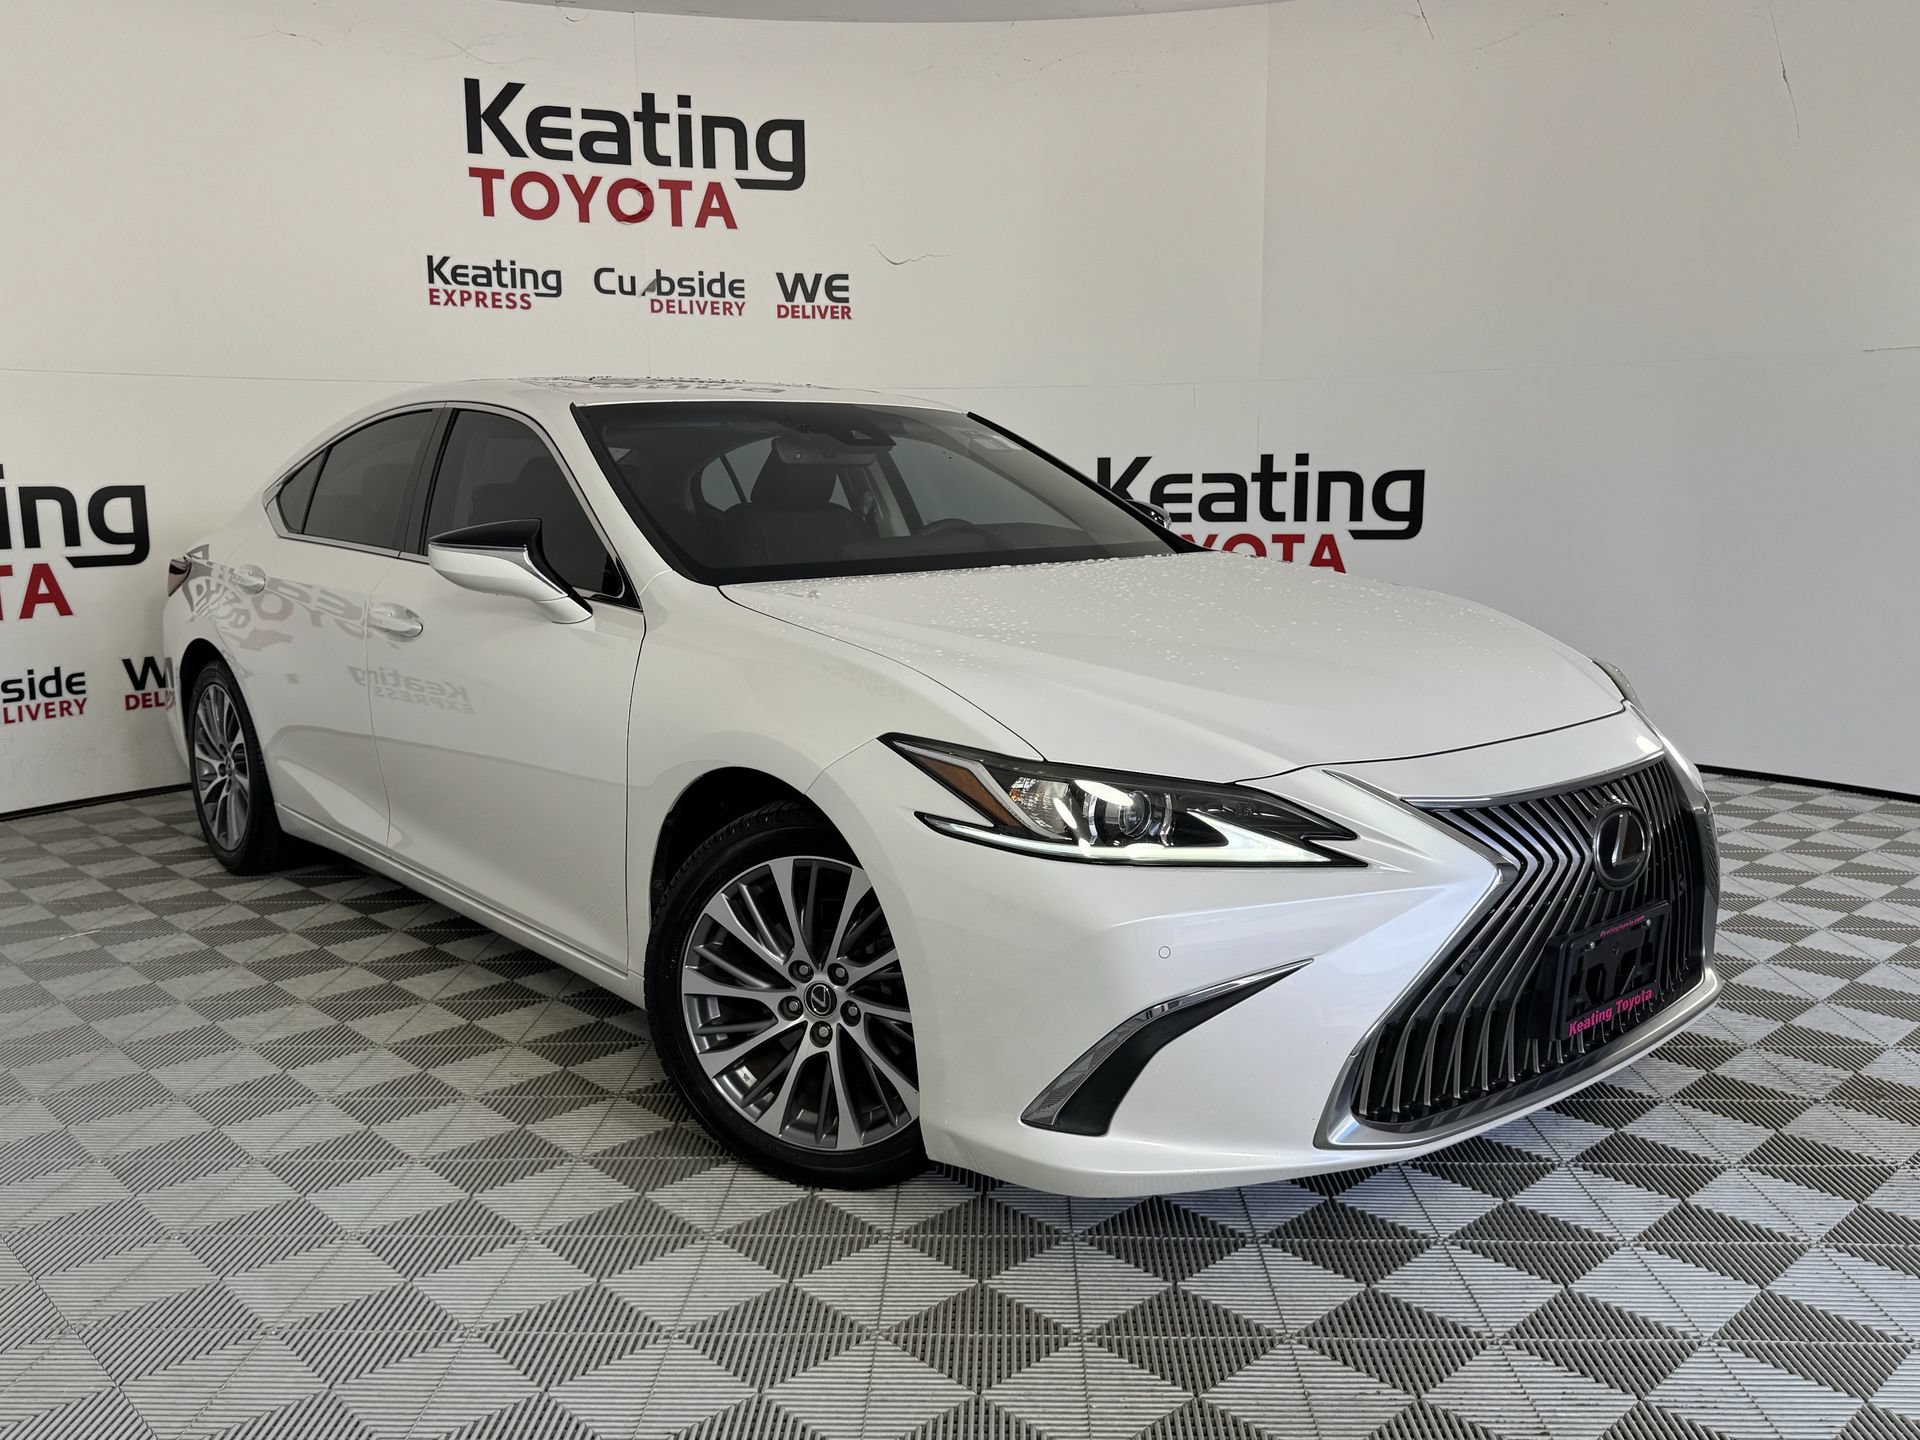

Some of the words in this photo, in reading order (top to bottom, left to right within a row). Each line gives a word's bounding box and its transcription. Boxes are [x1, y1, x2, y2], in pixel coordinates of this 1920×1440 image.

[464, 77, 806, 190] Keating
[468, 166, 738, 230] TOYOTA
[426, 254, 562, 298] Keating
[593, 267, 746, 299] Cubside
[776, 272, 850, 304] WE
[428, 288, 532, 310] EXPRESS
[650, 298, 746, 316] DELIVERY
[776, 304, 852, 320] DELIVER
[1097, 453, 1426, 540] Keating
[0, 563, 73, 620] A
[0, 666, 86, 704] side
[3, 698, 87, 724] LIVERY
[1569, 1007, 1613, 1037] Keating
[1616, 989, 1653, 1014] Toyota
